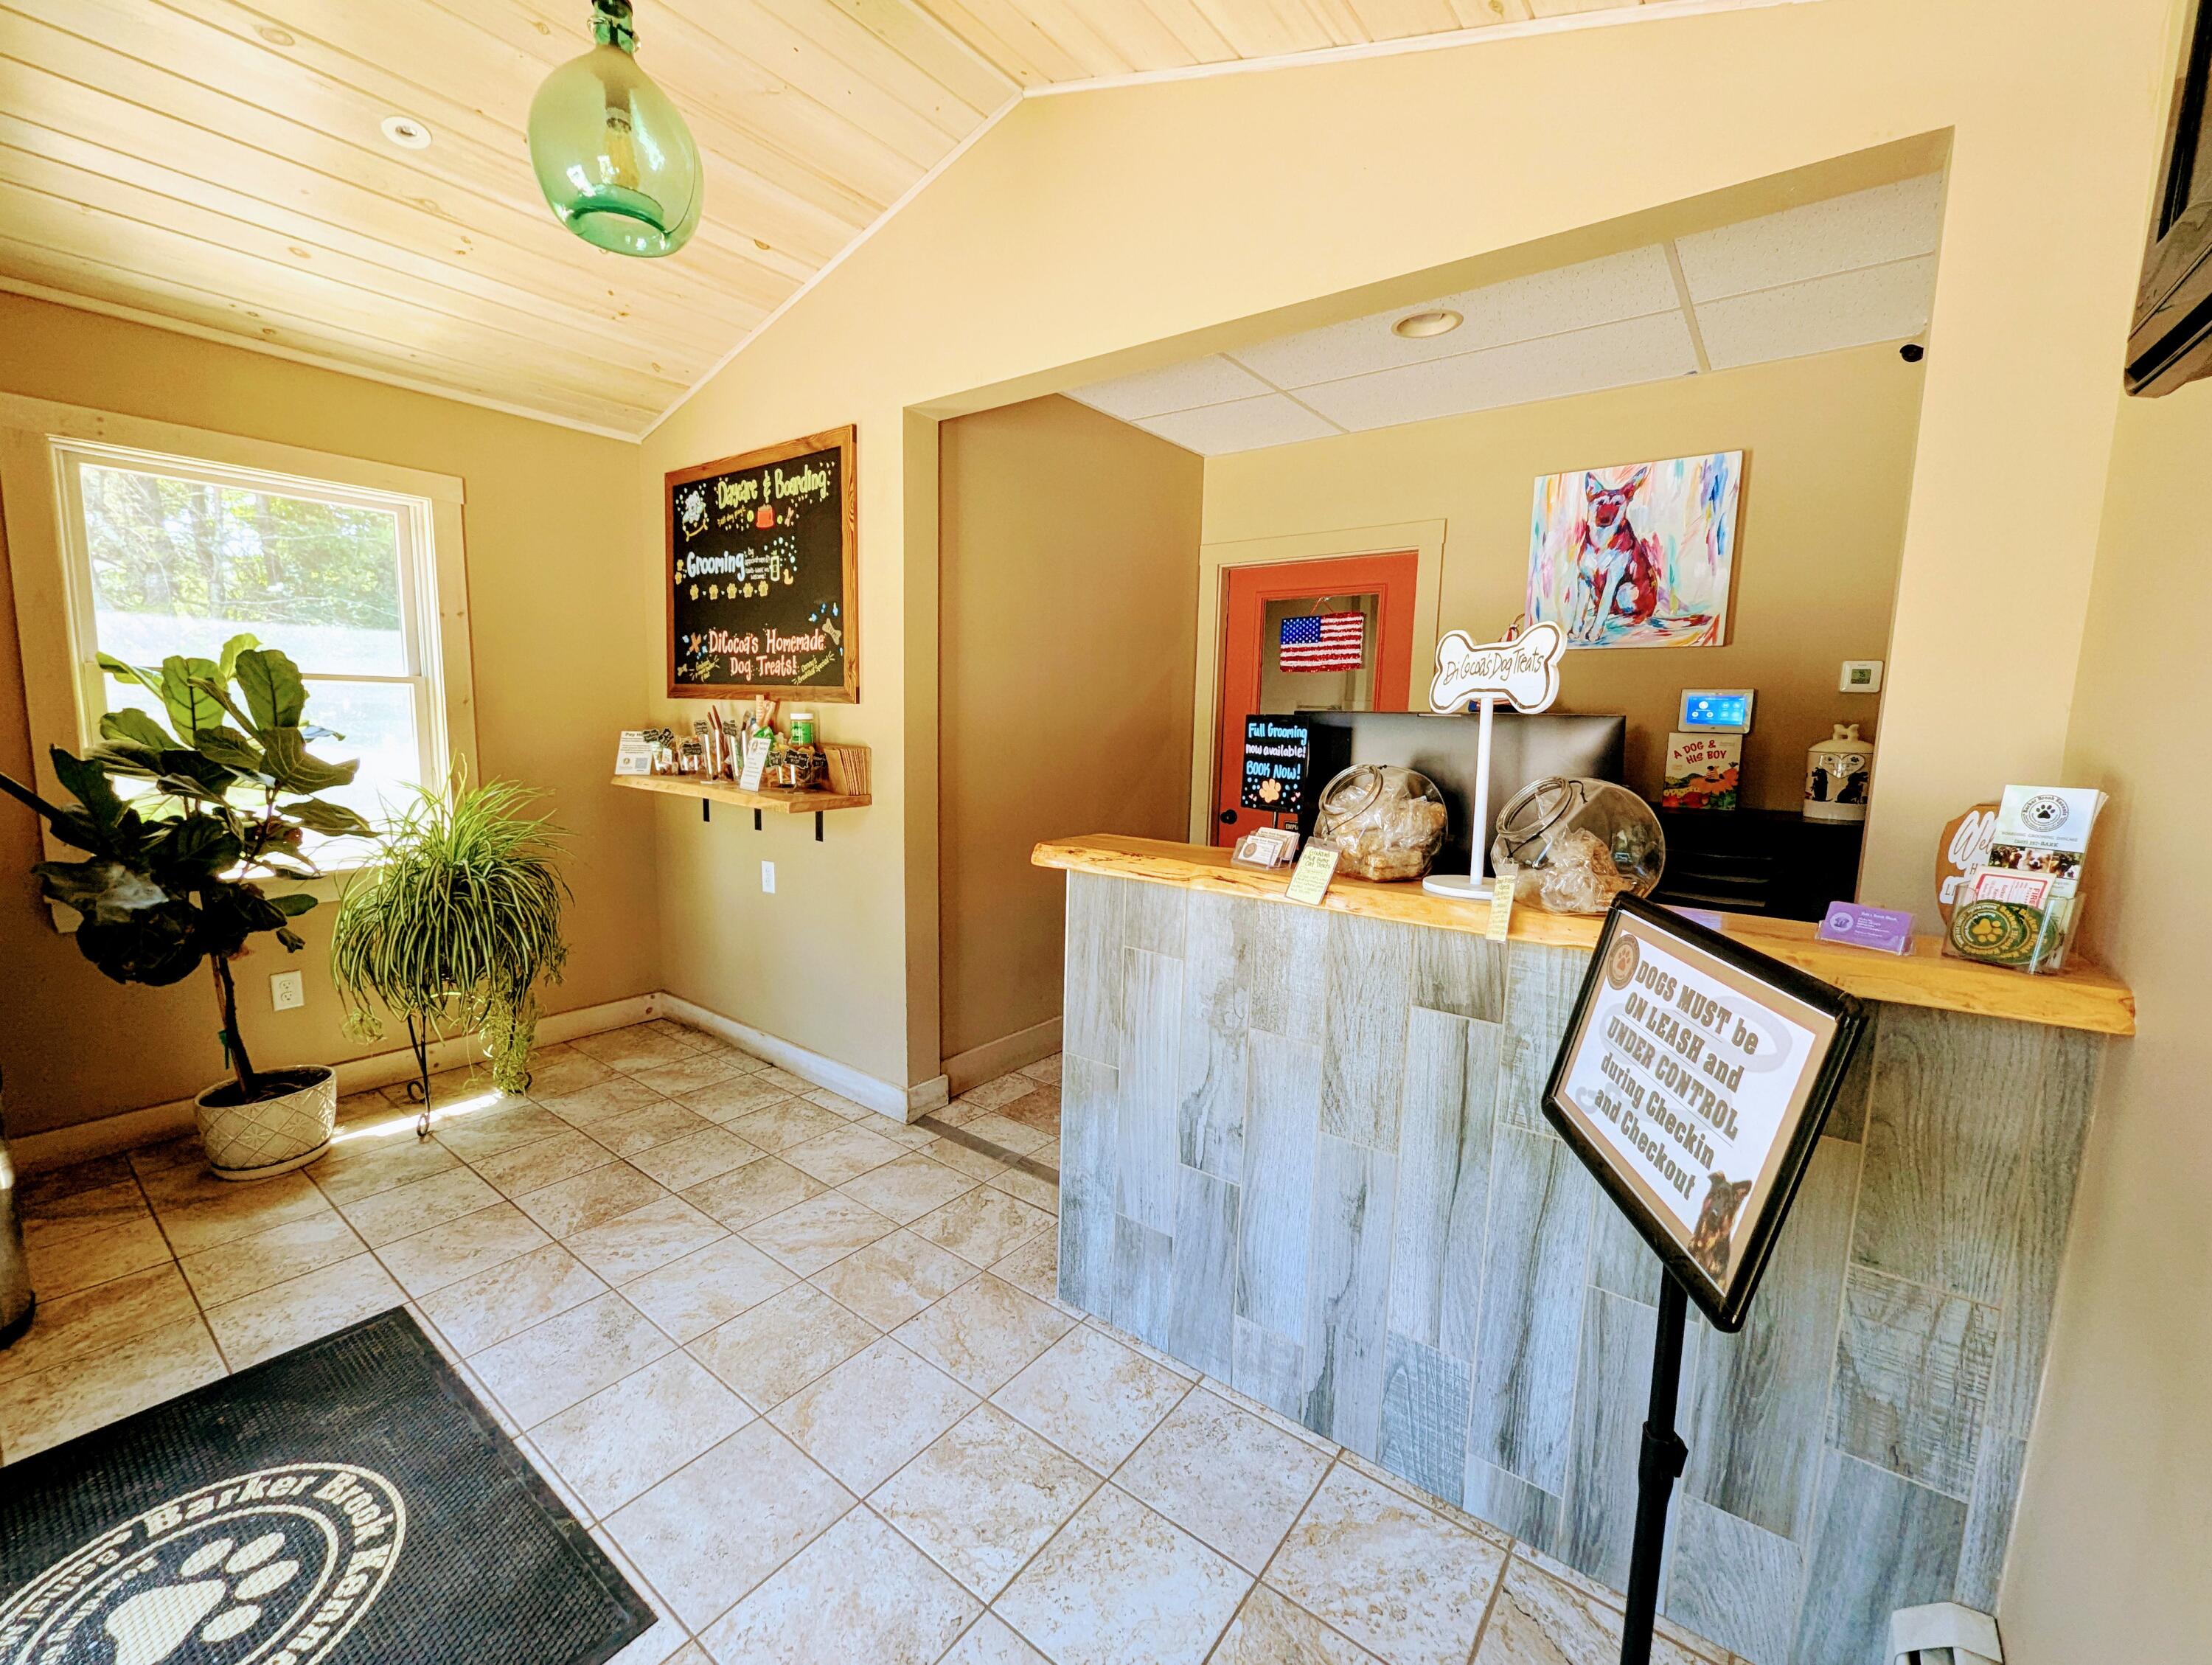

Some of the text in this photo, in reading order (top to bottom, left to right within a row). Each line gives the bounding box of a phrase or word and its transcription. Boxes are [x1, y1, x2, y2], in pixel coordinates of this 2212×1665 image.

[718, 464, 827, 509] Daycare & Boarding
[686, 551, 746, 583] Grooming
[748, 546, 754, 557] by
[709, 628, 825, 655] DiCocoa's Homemade
[730, 656, 752, 681] Dog
[756, 655, 798, 676] Treats!
[1488, 652, 1512, 681] Dog
[1513, 647, 1544, 674] Treats
[1245, 743, 1307, 758] now available!
[1248, 723, 1308, 746] Full Grooming
[1674, 749, 1683, 759] A
[1683, 741, 1704, 754] DOG
[1708, 740, 1717, 748] &
[1246, 759, 1270, 777] BOOK
[1686, 750, 1727, 764] HIS BOY
[1953, 818, 1996, 862] Wel
[1634, 960, 1678, 1002] DOGS
[1675, 985, 1733, 1035] MUST
[1731, 1018, 1759, 1054] be
[1624, 992, 1745, 1094] ON LEASH and
[1607, 1015, 1739, 1141] UNDER CONTROL
[1600, 1052, 1715, 1171] during Checkin
[1594, 1088, 1697, 1201] and Checkout
[145, 1475, 319, 1537] Barker
[312, 1471, 394, 1546] Brook
